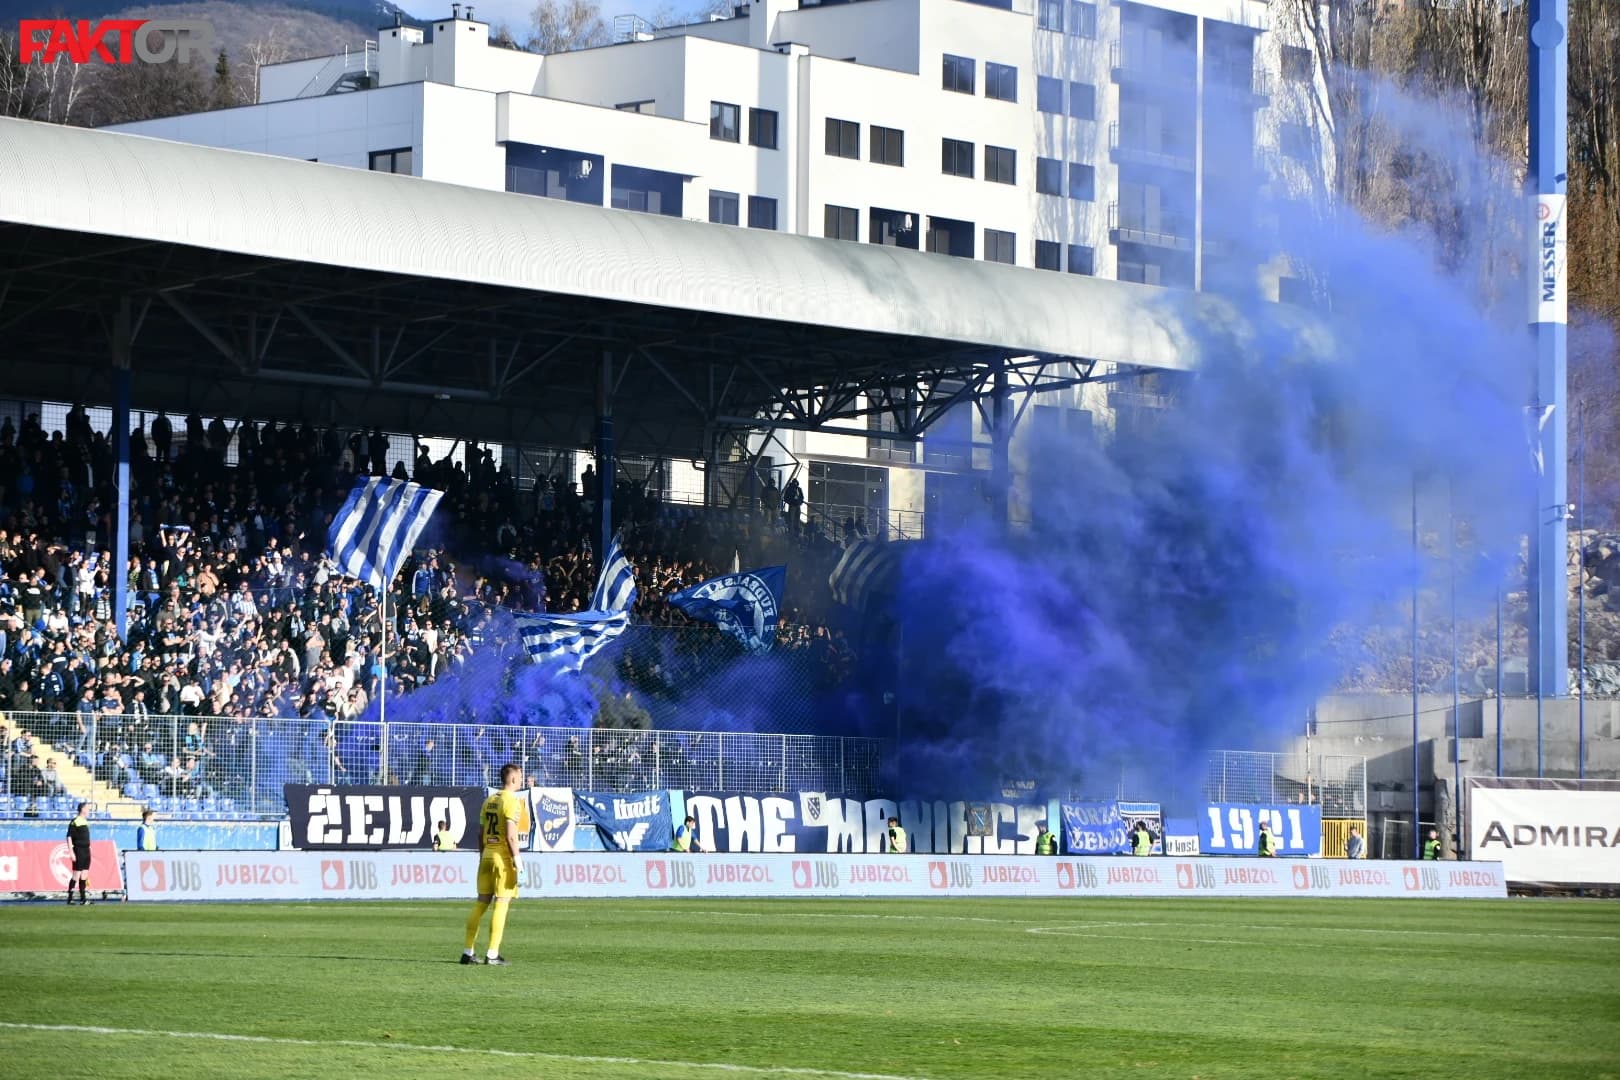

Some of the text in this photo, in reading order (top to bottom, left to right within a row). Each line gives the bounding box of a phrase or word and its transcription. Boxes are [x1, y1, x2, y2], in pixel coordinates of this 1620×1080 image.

[1542, 221, 1556, 302] MESSER
[486, 812, 500, 835] 72
[612, 794, 661, 820] limit
[687, 795, 796, 853] THE
[1207, 807, 1304, 849] 1921
[169, 860, 1499, 892] JUB JUBIZOL JUB JUBIZOL UB JUBIZOL JUB JUBIZOL JUB JUBIZOL JUB JUBIZOL JUB JUBIZOL JUB JUBIZOL JUB JUBIZOL JUB JUBIZOL
